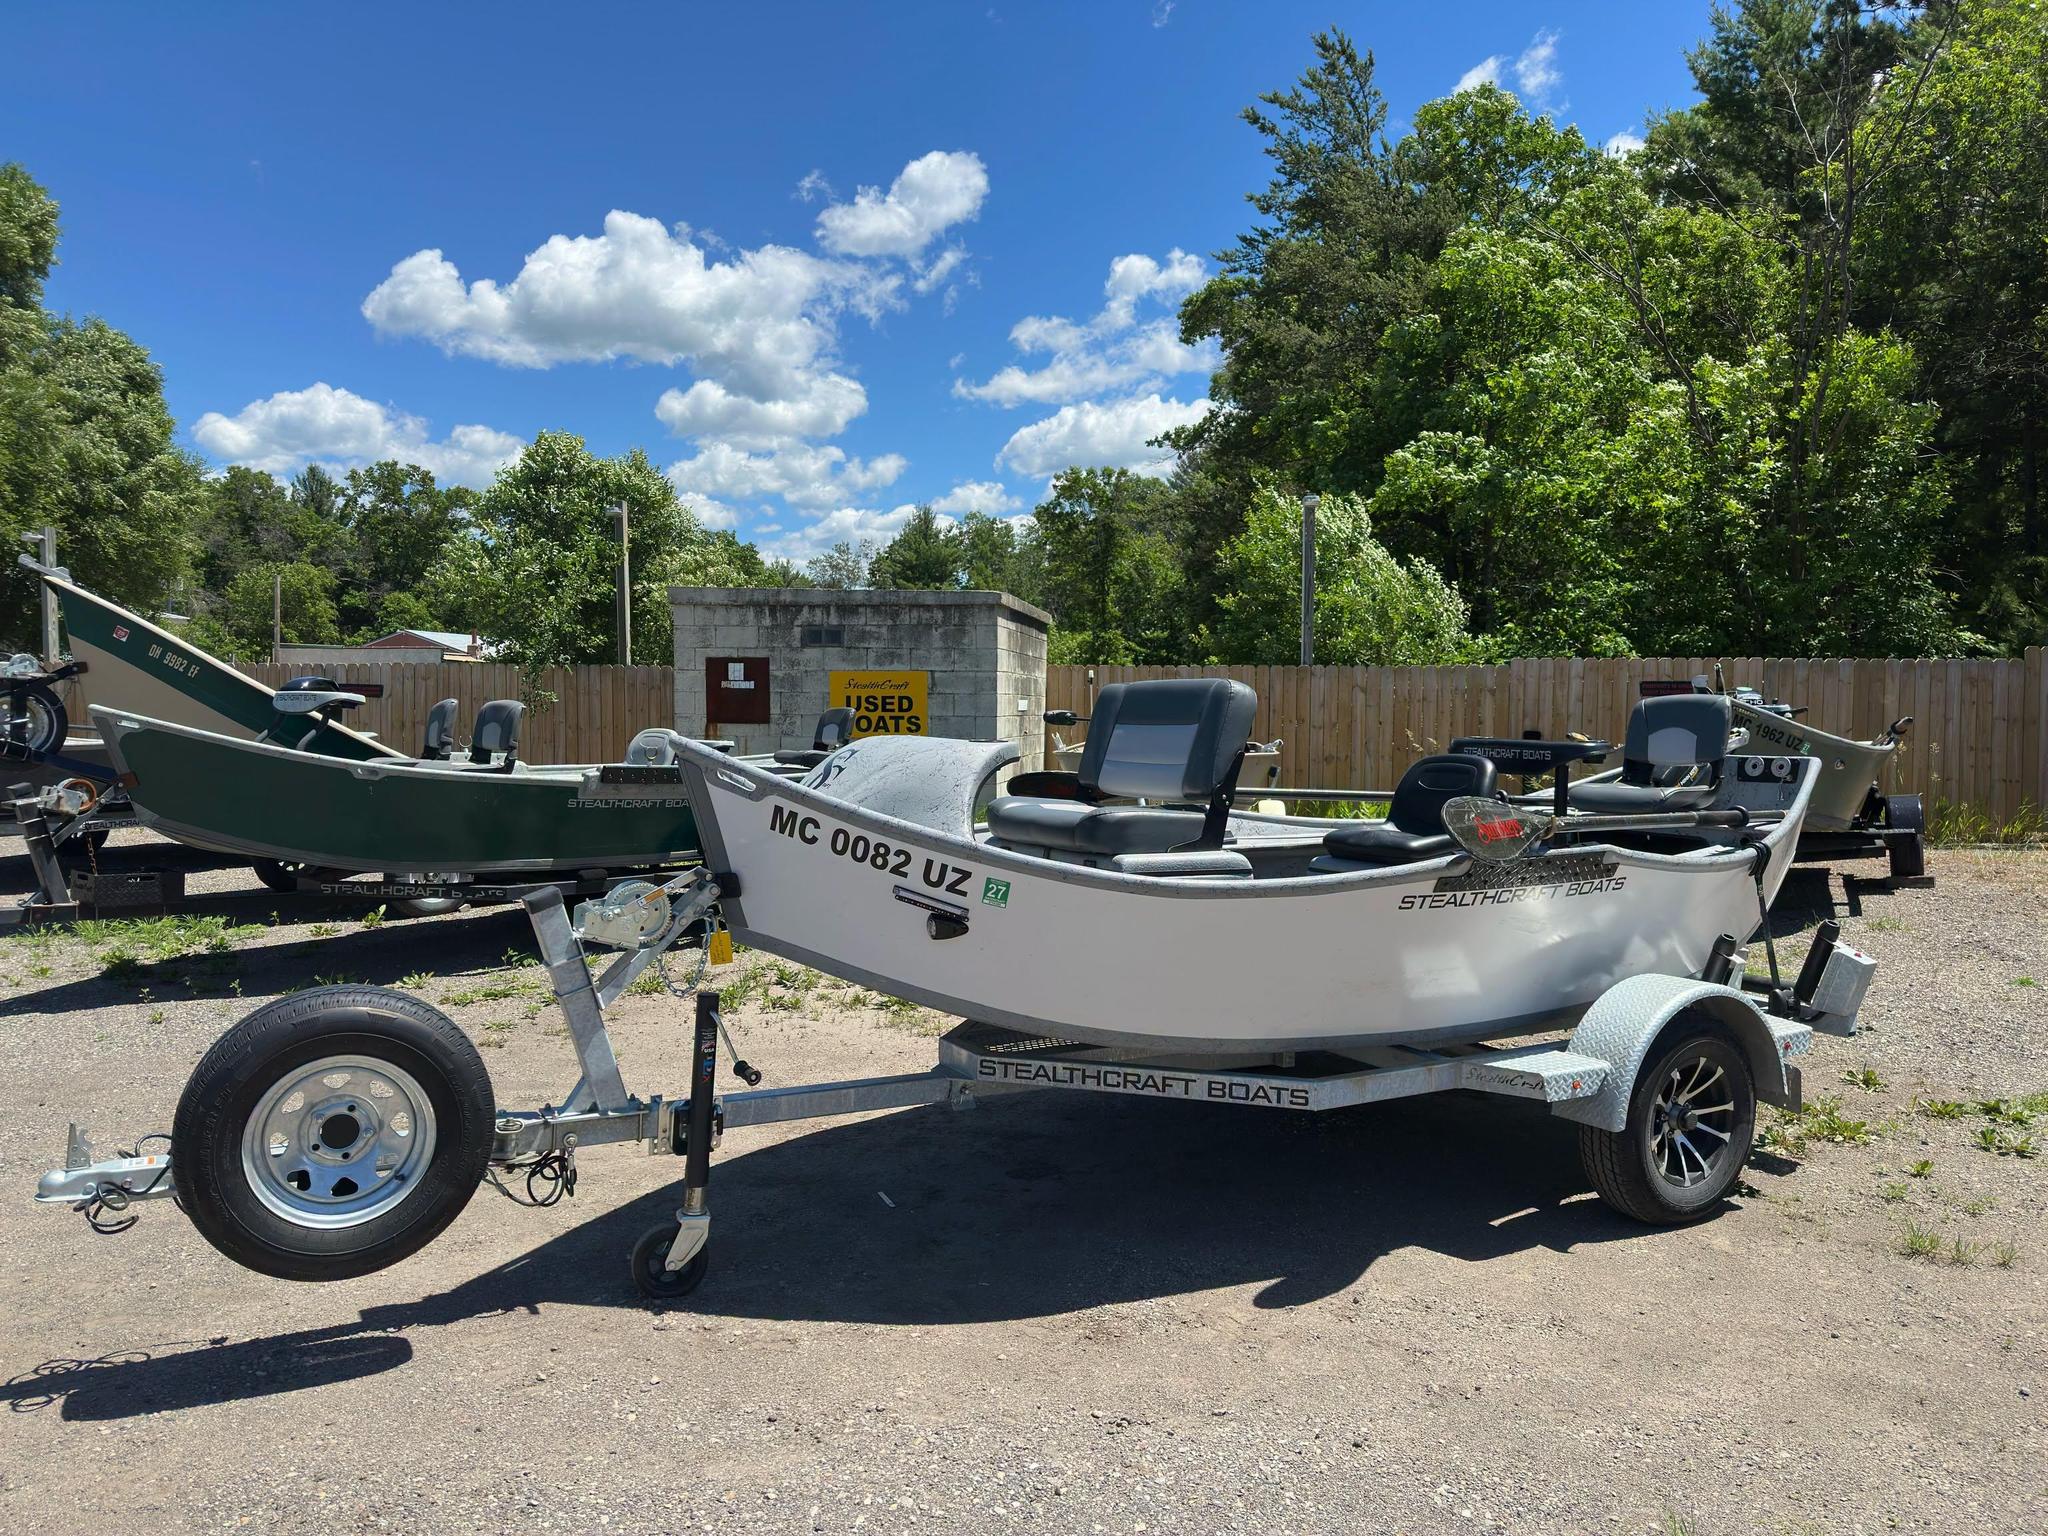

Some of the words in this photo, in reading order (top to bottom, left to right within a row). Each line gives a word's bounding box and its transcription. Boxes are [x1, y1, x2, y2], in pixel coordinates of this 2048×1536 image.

[163, 651, 188, 673] 9982
[845, 694, 914, 713] USED
[855, 714, 922, 734] OATS
[1756, 723, 1784, 744] 1962
[1785, 735, 1804, 751] UZ
[1464, 746, 1520, 759] STEALTHCRAFT
[1522, 749, 1552, 760] BOATS
[567, 798, 662, 808] STEALTHCRAFT
[665, 799, 690, 808] BOA
[83, 819, 142, 831] STEALTHCRA
[769, 804, 821, 845] MC
[830, 828, 912, 879] 0082
[922, 858, 973, 898] UZ
[987, 883, 1007, 899] 27
[1398, 884, 1563, 910] STEALTHCRAFT
[1565, 877, 1627, 897] BOATS
[978, 1059, 1197, 1096] STEALTHCRAFT
[1207, 1080, 1309, 1107] BOATS
